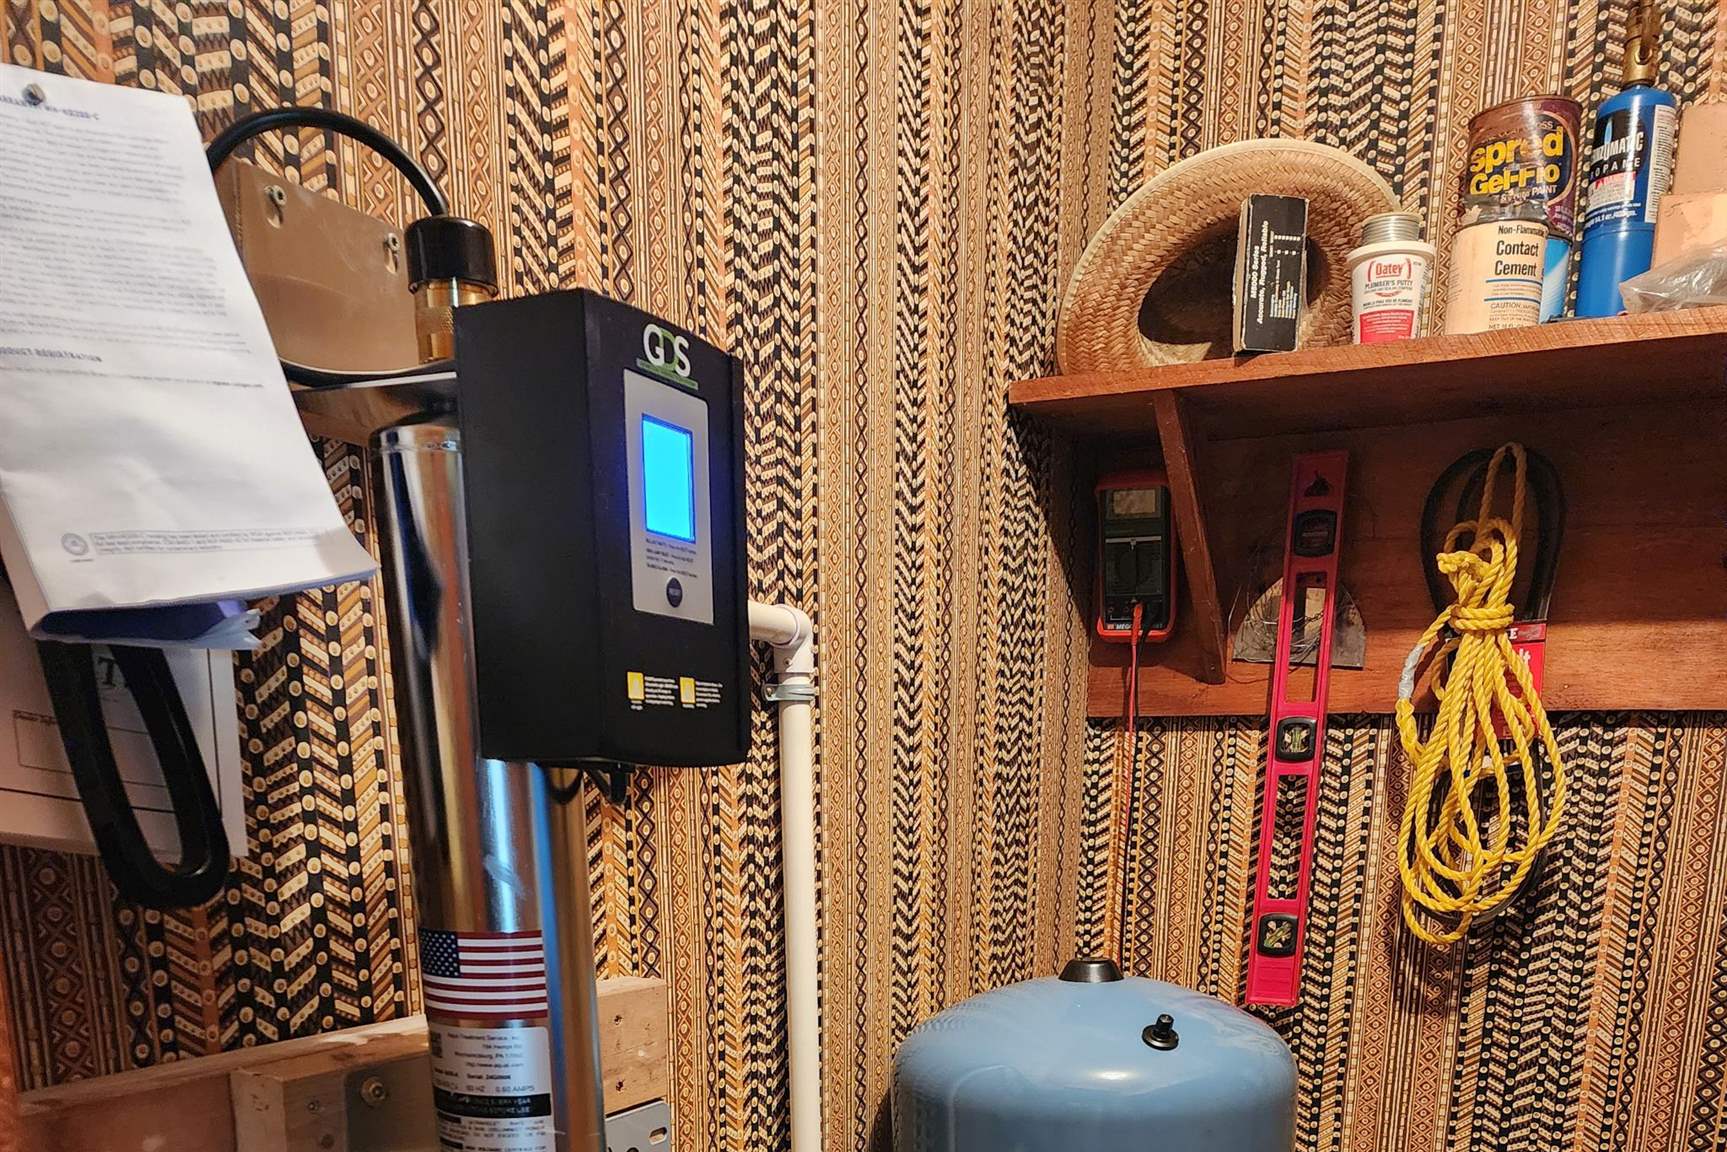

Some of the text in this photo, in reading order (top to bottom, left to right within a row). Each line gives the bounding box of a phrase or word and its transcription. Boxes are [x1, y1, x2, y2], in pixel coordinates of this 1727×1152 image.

[1470, 164, 1560, 195] Gel-Flo
[1531, 185, 1557, 196] PAINT
[1252, 245, 1260, 270] Series
[1496, 240, 1539, 257] Contact
[1257, 220, 1269, 324] Accurate, Rugged, Reliable
[1375, 262, 1405, 276] Oatey
[1494, 260, 1537, 277] Cement
[643, 323, 691, 378] GDS
